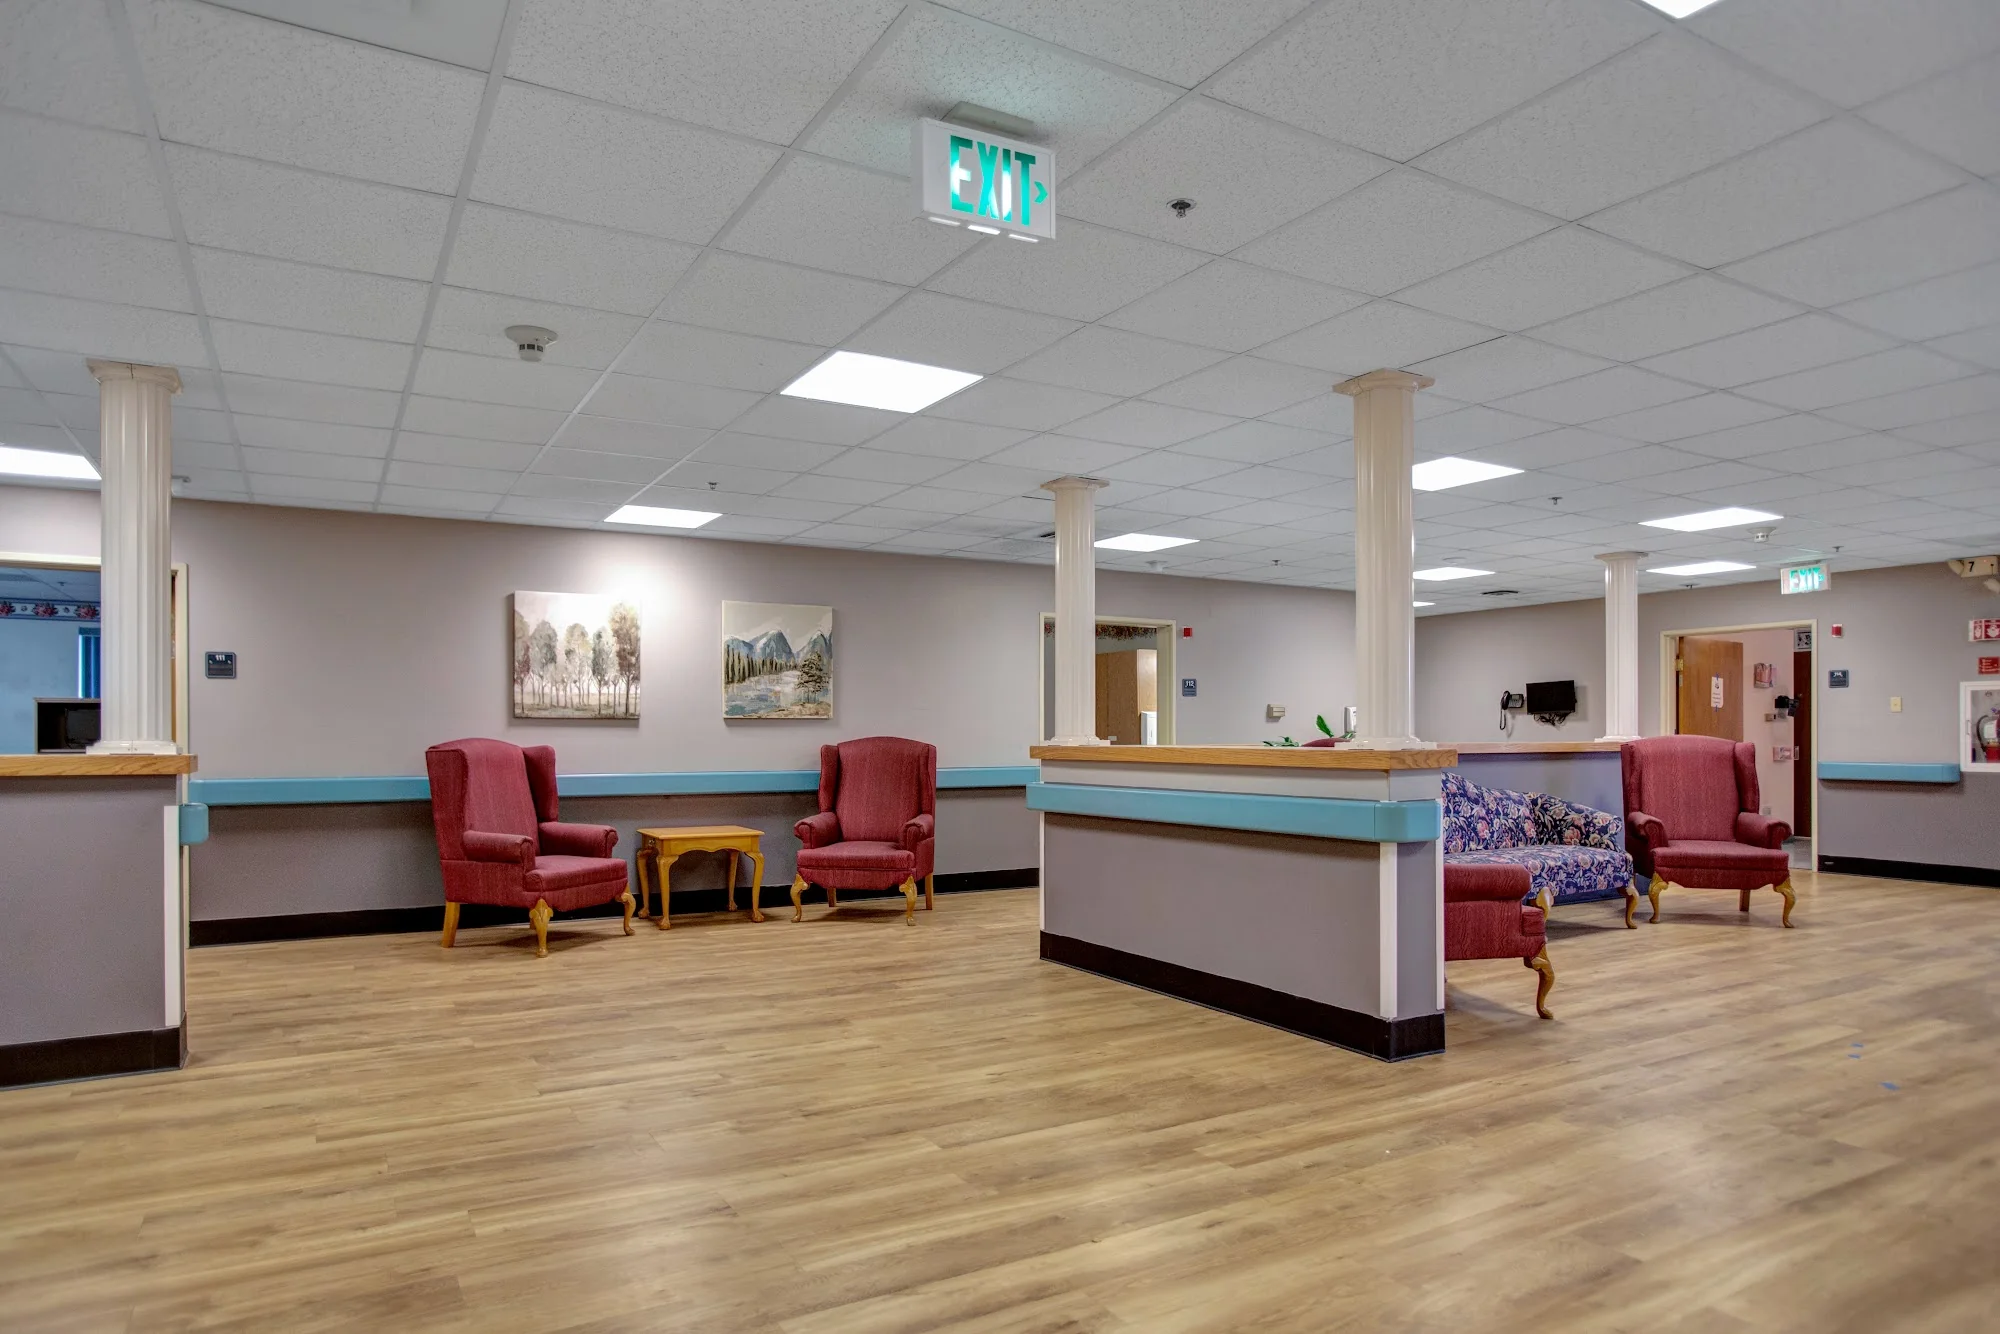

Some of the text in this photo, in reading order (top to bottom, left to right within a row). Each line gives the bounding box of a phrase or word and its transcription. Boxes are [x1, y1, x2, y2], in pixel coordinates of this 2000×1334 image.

[950, 135, 1036, 227] EXIT
[1968, 561, 1975, 572] 7
[1789, 567, 1821, 592] EXIT
